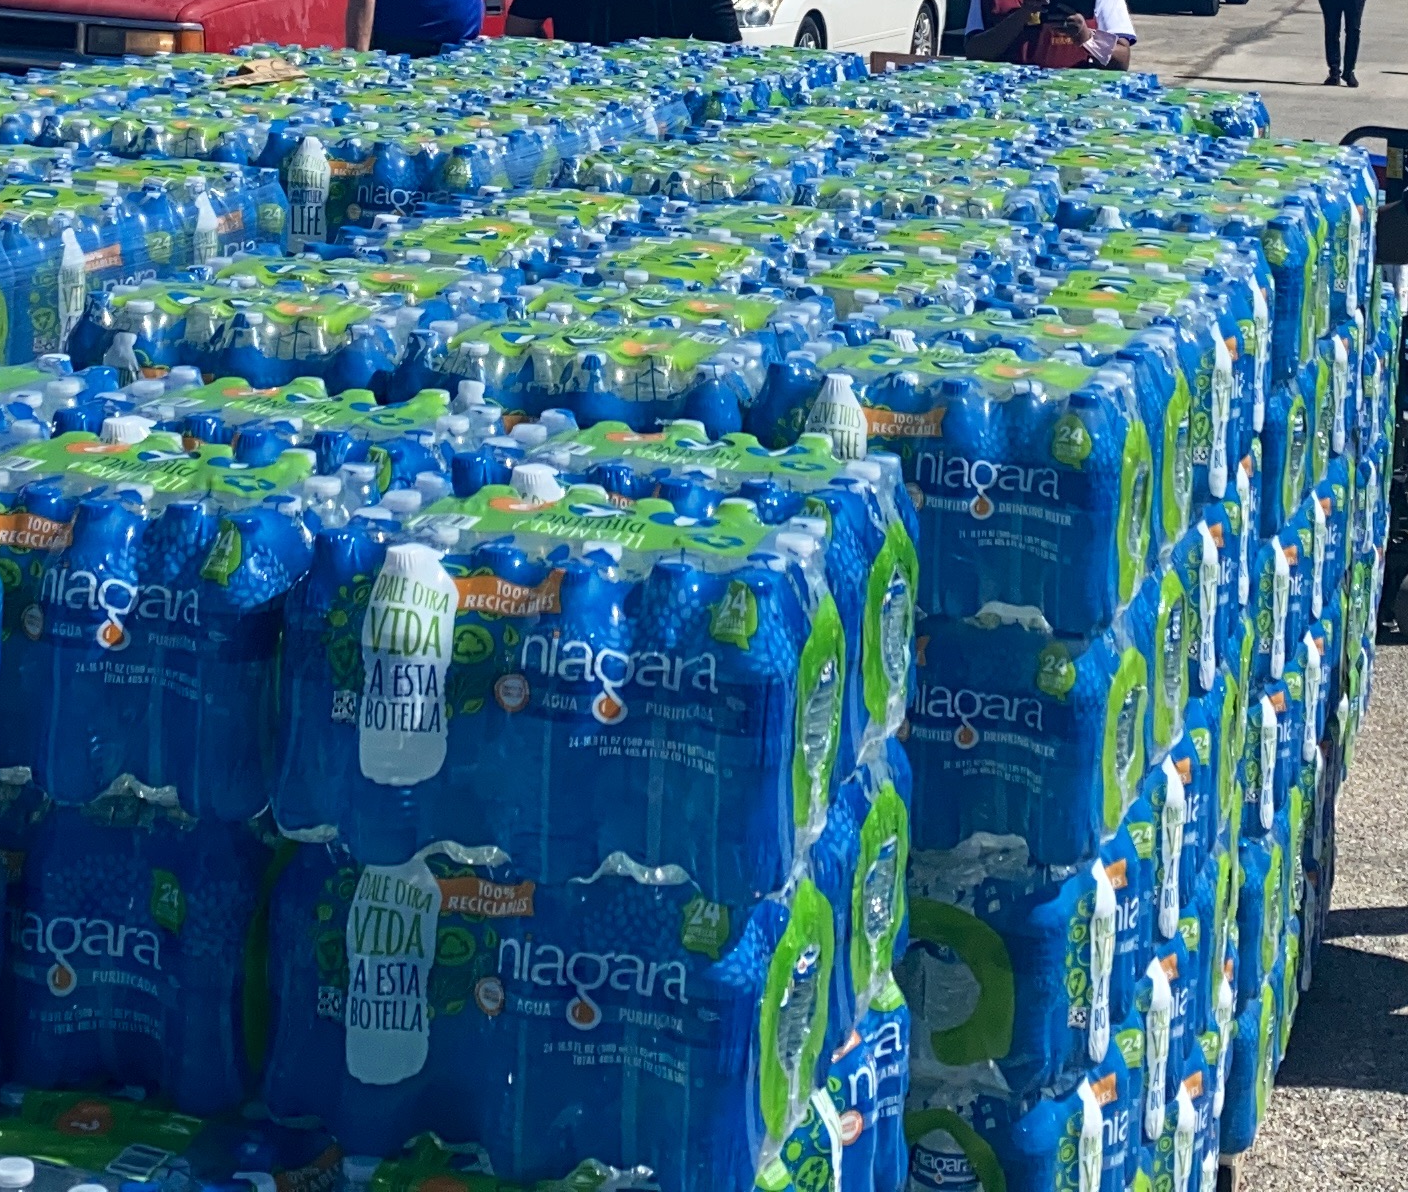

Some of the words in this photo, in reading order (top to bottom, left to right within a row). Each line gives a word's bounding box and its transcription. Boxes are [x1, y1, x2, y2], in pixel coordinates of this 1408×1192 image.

[291, 205, 322, 237] LIFE
[838, 402, 861, 429] THIS
[1058, 426, 1084, 443] 24
[914, 451, 1060, 520] niagara
[41, 567, 201, 651] niagara
[375, 572, 409, 603] DALE
[411, 581, 450, 615] OTRA
[51, 621, 83, 637] AGUA
[369, 606, 442, 659] VIDA
[369, 658, 384, 695] A
[393, 663, 439, 699] ESTA
[520, 629, 719, 726] niagara
[1043, 654, 1068, 676] 24
[364, 697, 441, 733] BOTELLA
[541, 693, 578, 712] AGUA
[645, 699, 714, 723] PURIFICADA
[1132, 827, 1153, 846] 24
[359, 871, 392, 903] DALE
[394, 879, 433, 915] OTRA
[447, 894, 529, 915] RECICLABLES
[477, 881, 517, 899] 100%
[690, 897, 720, 928] 24
[354, 906, 425, 959] VIDA
[1179, 920, 1199, 939] 24
[353, 958, 368, 995] A
[375, 963, 421, 998] ESTA
[497, 933, 689, 1030] niagara
[349, 996, 423, 1033] BOTELLA
[516, 998, 552, 1017] AGUA
[1121, 1034, 1143, 1053] 24
